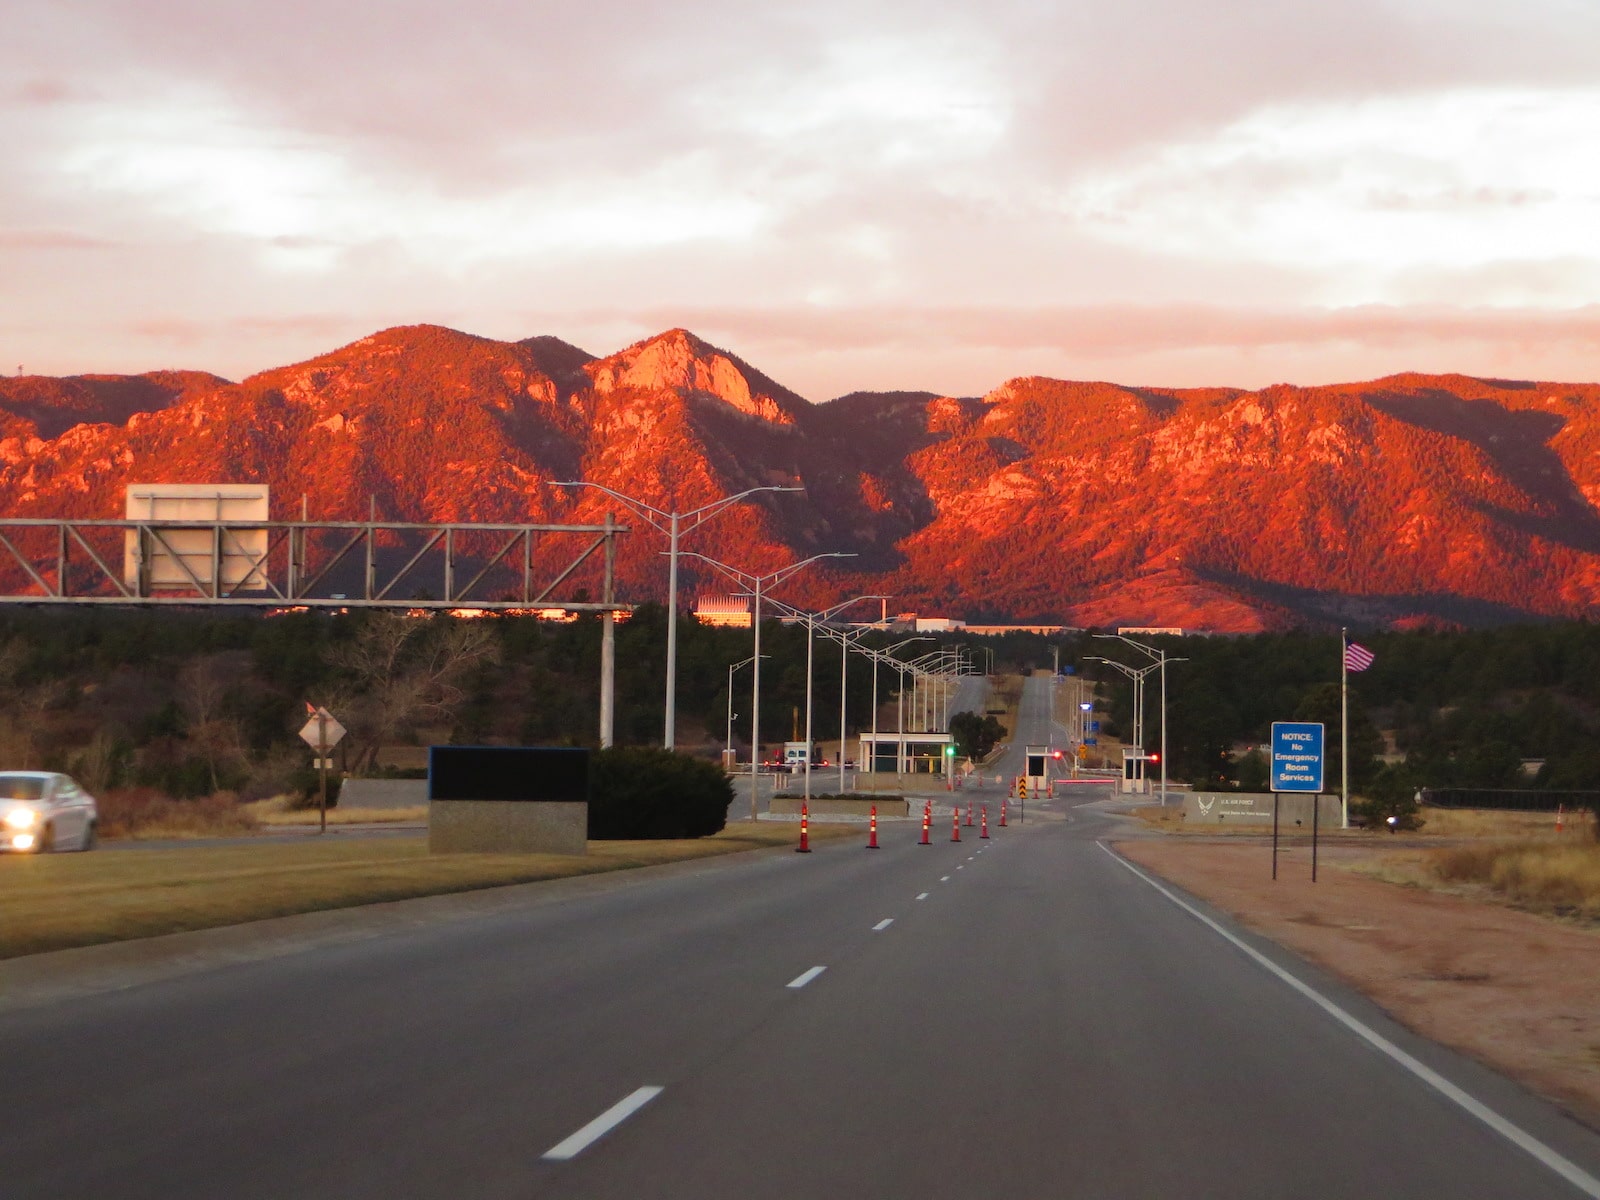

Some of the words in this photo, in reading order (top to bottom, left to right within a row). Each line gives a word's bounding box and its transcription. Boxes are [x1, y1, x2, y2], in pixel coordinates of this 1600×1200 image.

[1282, 733, 1313, 741] NOTICE:
[1292, 743, 1303, 751] No
[1275, 753, 1319, 762] Emergency
[1285, 763, 1309, 771] Room
[1280, 773, 1314, 781] Services
